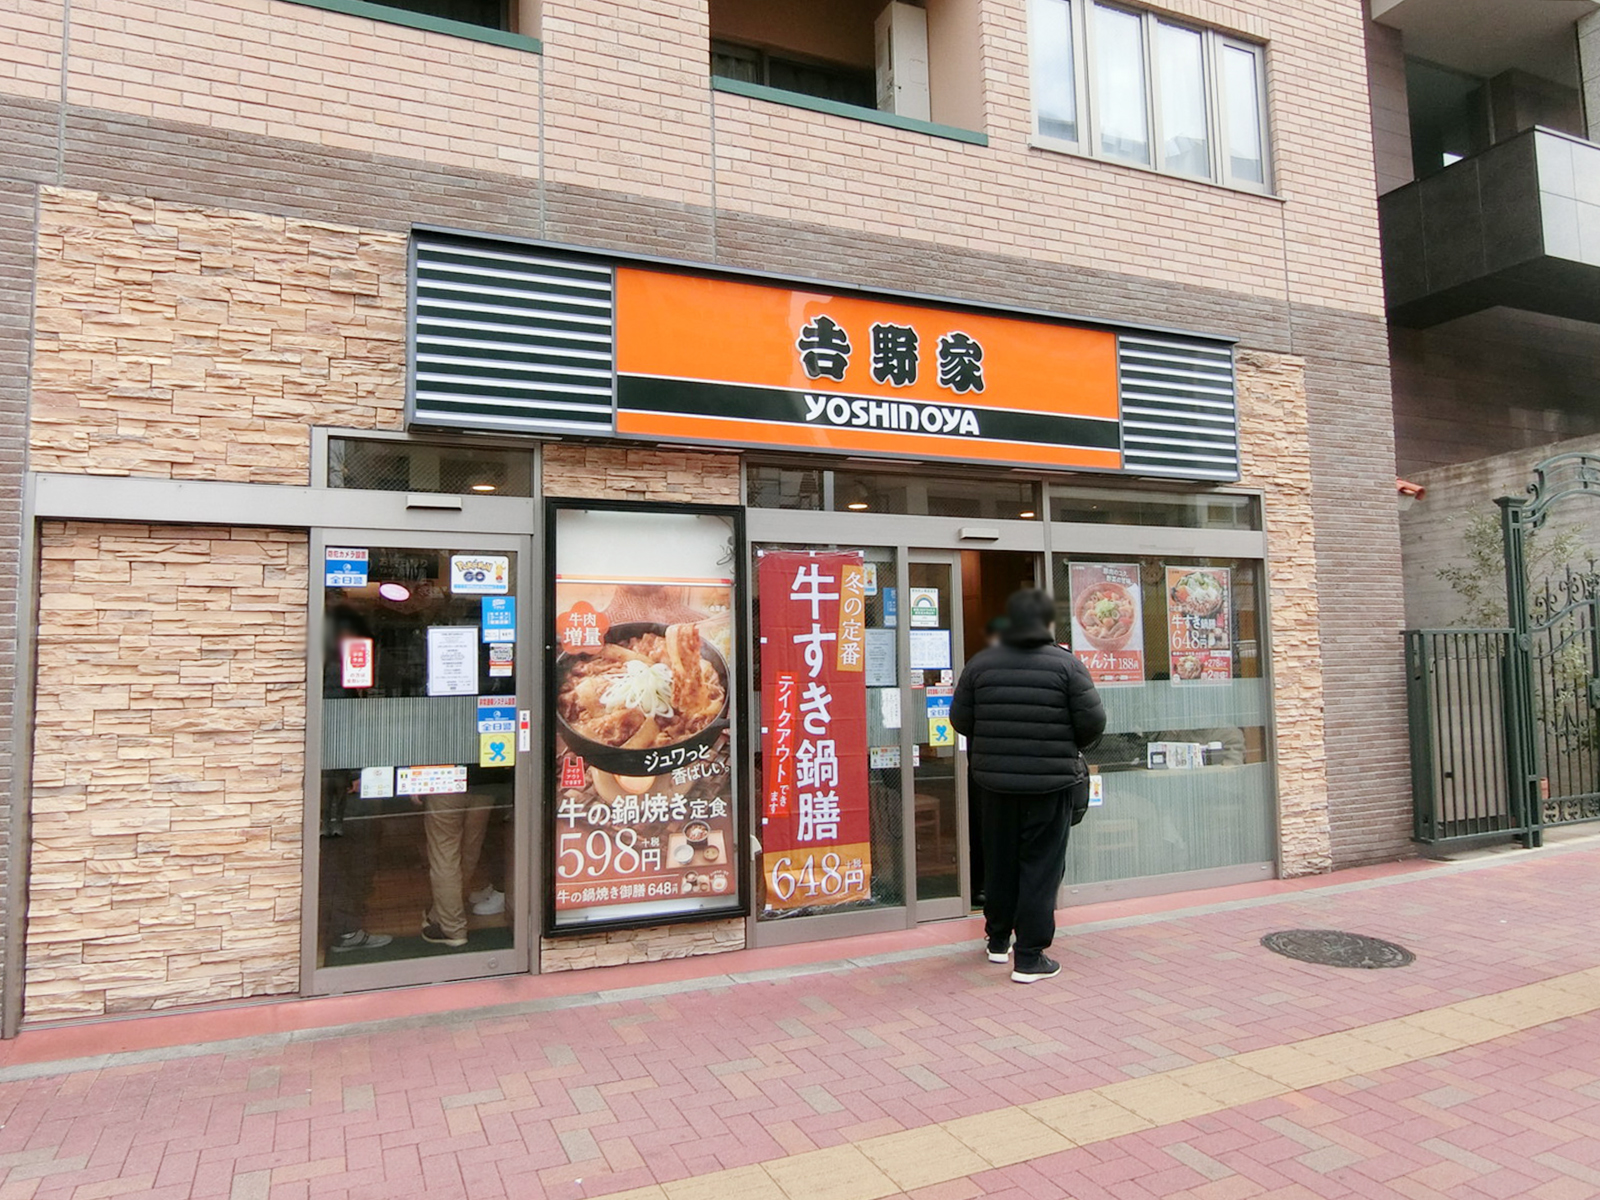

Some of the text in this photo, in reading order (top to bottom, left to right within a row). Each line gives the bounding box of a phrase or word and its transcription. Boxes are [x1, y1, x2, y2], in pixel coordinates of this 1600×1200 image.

[804, 394, 980, 436] YOSHINOYA
[464, 571, 485, 582] GO
[569, 612, 597, 627] 牛肉
[840, 570, 864, 665] 冬の定番
[563, 627, 602, 646] 増量
[790, 564, 841, 841] 牛すき鍋膳
[644, 744, 711, 773] ジュワっと
[672, 761, 731, 786] 香ばしい。
[557, 793, 728, 829] 牛の鍋焼き定食
[556, 883, 646, 904] 牛の鍋焼き御膳
